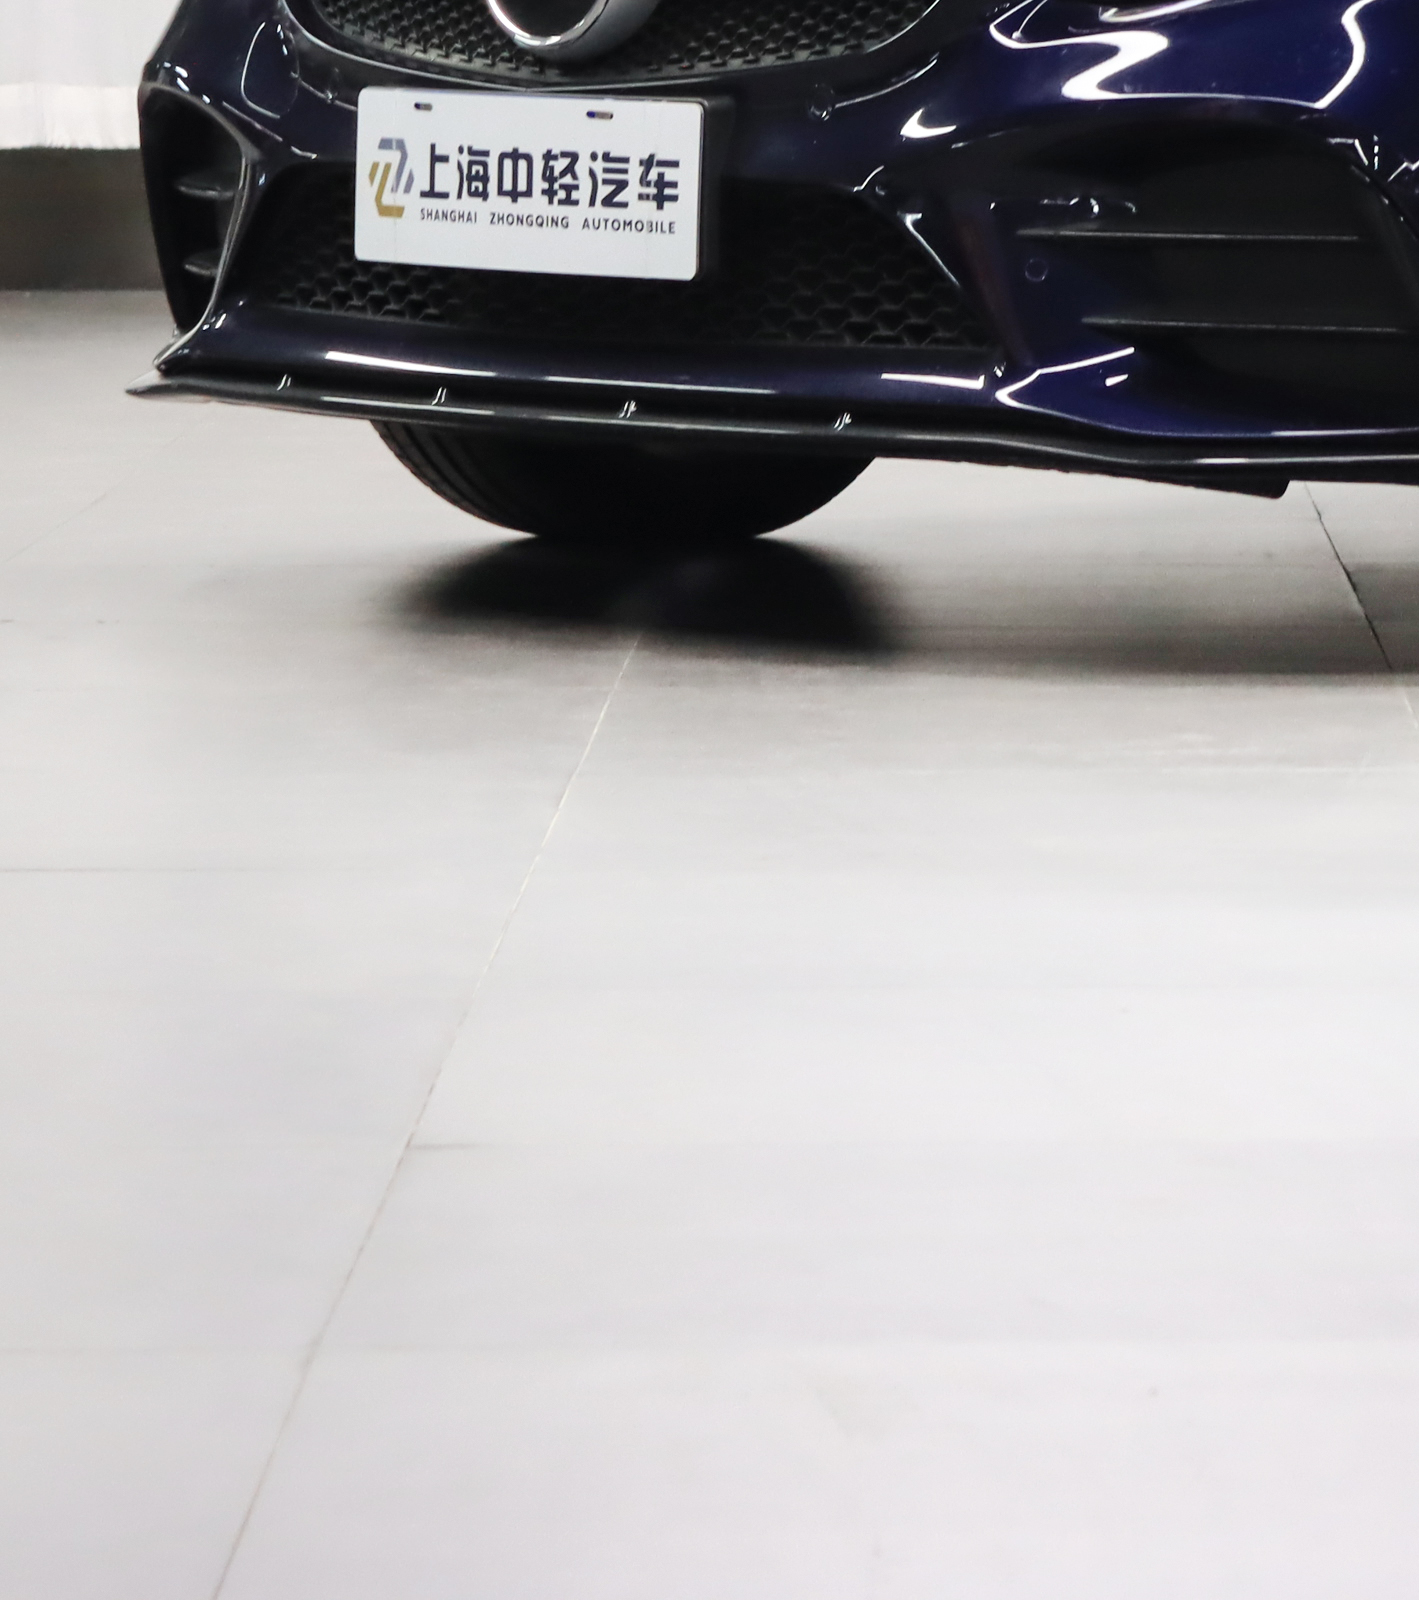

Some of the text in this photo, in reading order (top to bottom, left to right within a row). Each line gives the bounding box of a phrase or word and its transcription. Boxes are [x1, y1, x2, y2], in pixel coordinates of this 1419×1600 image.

[419, 143, 680, 211] 上海中轻汽车
[420, 208, 676, 234] SHANGHAI ZHONGQING AUTOMOBILE
